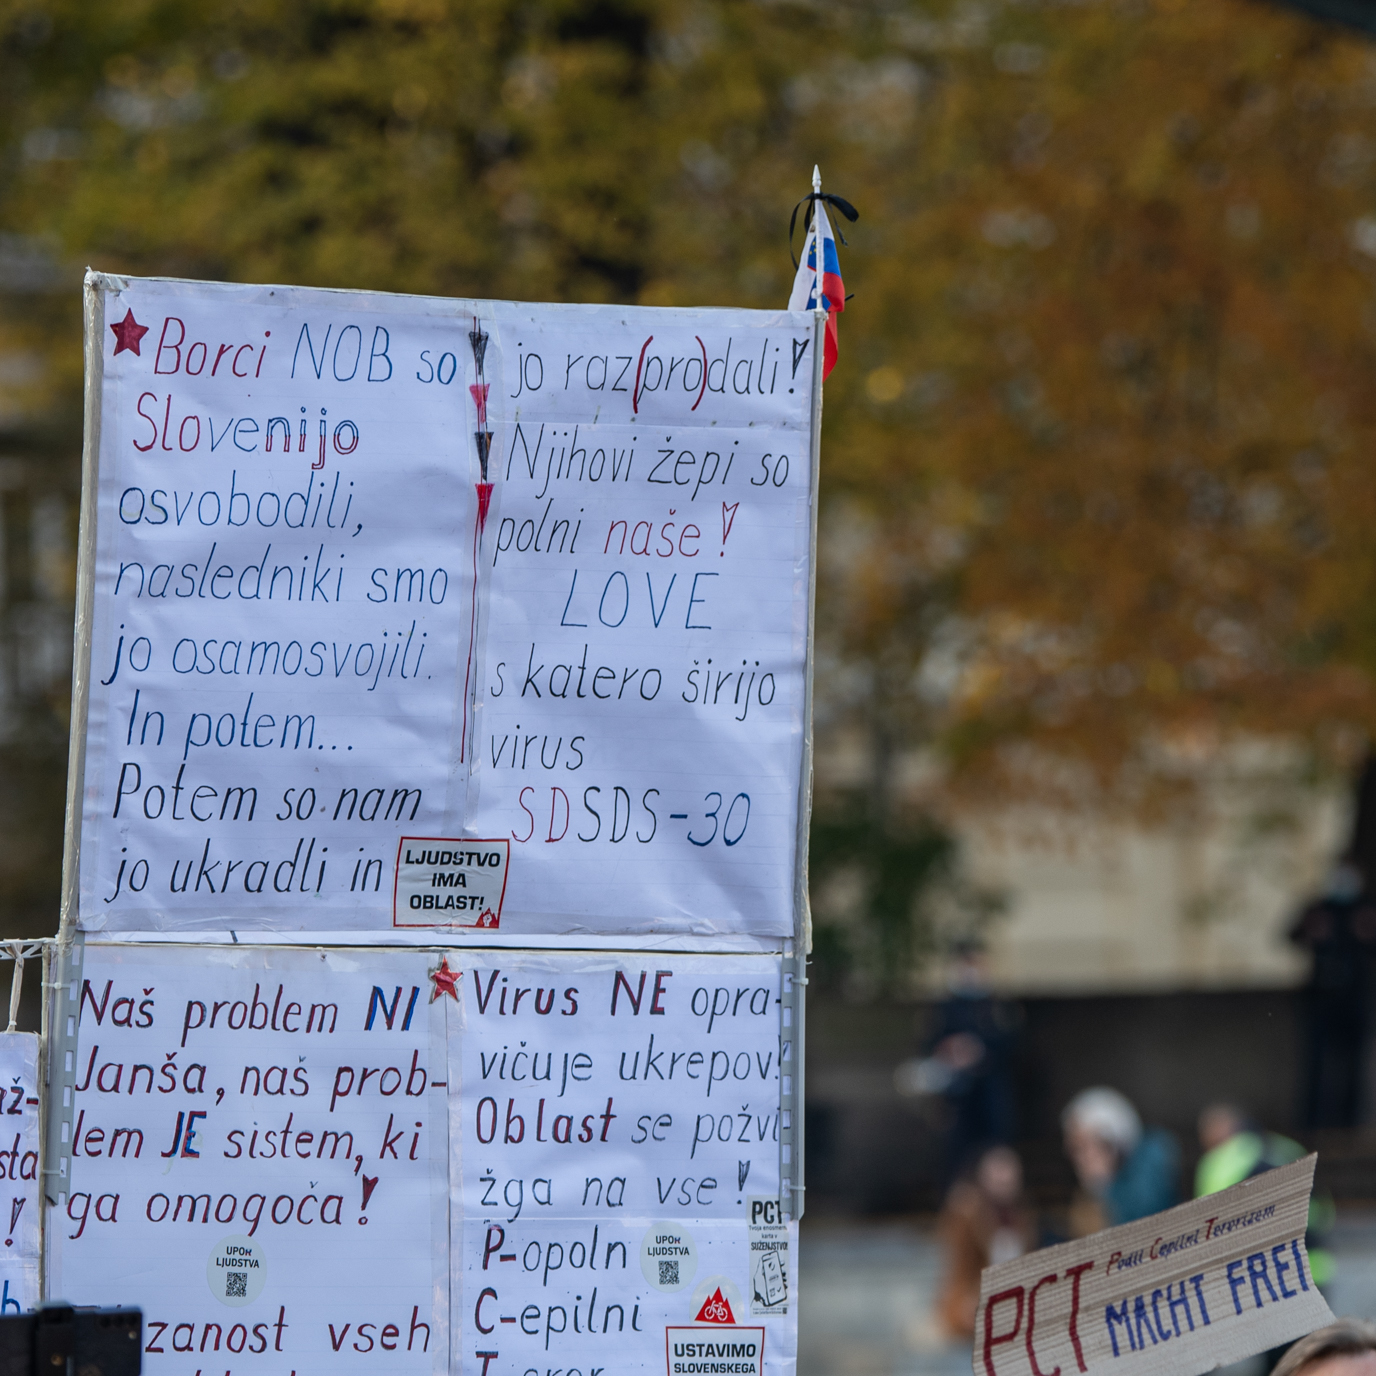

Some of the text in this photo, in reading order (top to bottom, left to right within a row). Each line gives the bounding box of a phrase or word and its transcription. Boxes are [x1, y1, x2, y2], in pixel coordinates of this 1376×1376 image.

[154, 316, 457, 385] Borci NOB so
[510, 342, 544, 398] jo
[133, 392, 360, 470] Slovenijo
[506, 423, 789, 501] Njihovi žepi so
[119, 469, 363, 537] osvobodili,
[493, 498, 584, 567] polni
[114, 542, 449, 605] nasledniki smo
[560, 569, 720, 630] LOVE
[101, 619, 432, 691] jo osamosvojili.
[490, 643, 776, 722] s katero širijo
[126, 689, 353, 761] In potem...
[490, 725, 585, 770] virus
[113, 762, 422, 822] Potem so nam
[511, 786, 751, 847] SDSDS-30
[103, 838, 384, 904] jo ukradli in
[405, 849, 501, 868] LJUDSTVO
[431, 872, 468, 888] IMA
[409, 894, 484, 911] OBLAST!
[79, 979, 420, 1047] Naš problem NI
[473, 969, 580, 1016] Virus
[610, 970, 673, 1017] NE
[75, 1045, 447, 1112] Janša, naš prob-
[479, 1041, 593, 1097] vičuje
[72, 1110, 423, 1175] lem JE sistem, ki
[476, 1097, 616, 1144] Oblast
[631, 1113, 673, 1143] se
[66, 1192, 120, 1239] ga
[478, 1168, 553, 1223] žga
[582, 1176, 626, 1207] na
[216, 1257, 259, 1268] LJUDSTVA
[648, 1247, 690, 1256] LJUDSTVA
[1105, 1239, 1310, 1358] MACHT FREI
[145, 1306, 431, 1354] zanost vseh
[674, 1343, 757, 1359] USTAVIMO
[674, 1362, 756, 1375] SLOVENSKEGA
